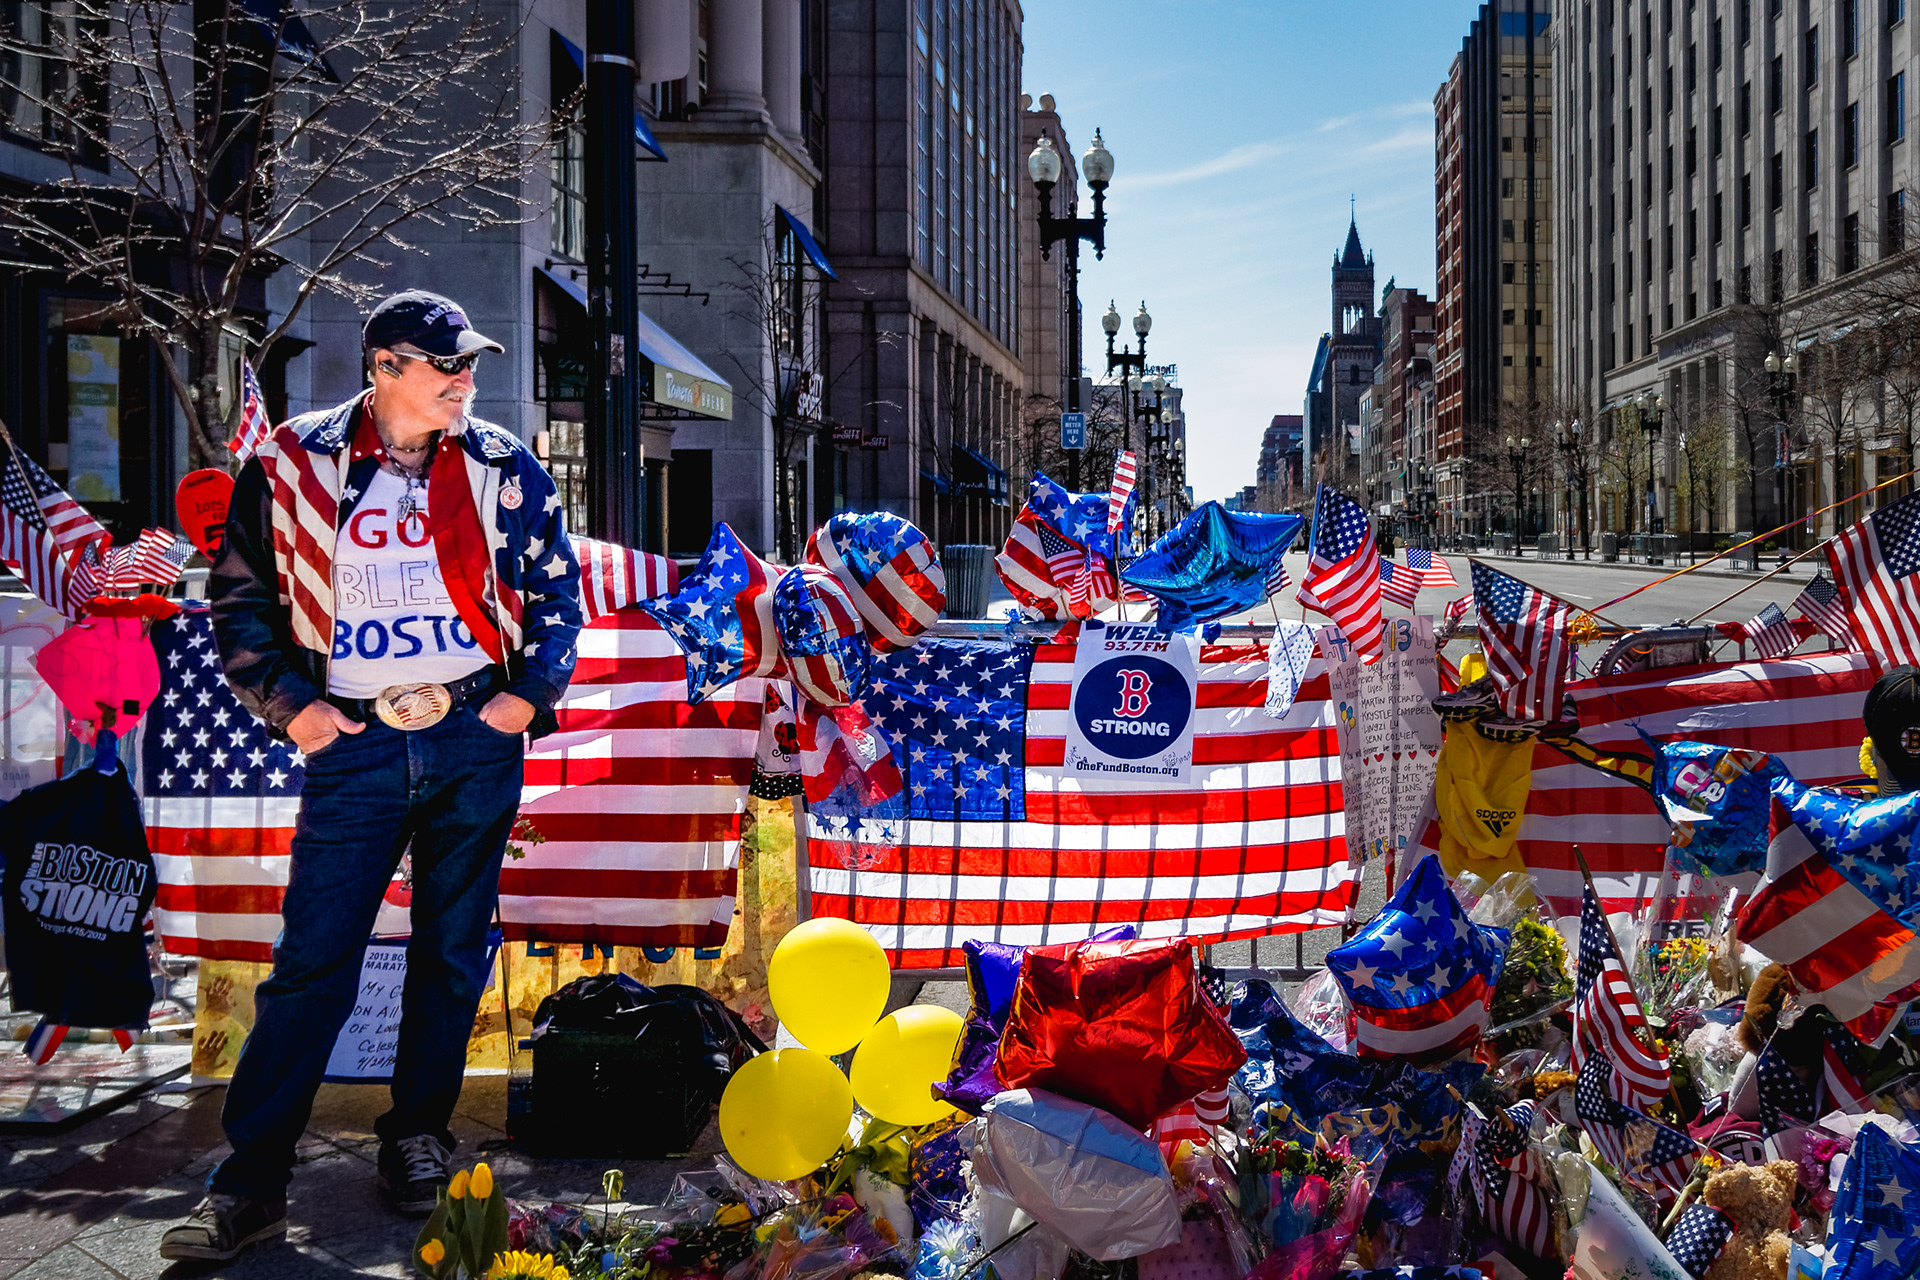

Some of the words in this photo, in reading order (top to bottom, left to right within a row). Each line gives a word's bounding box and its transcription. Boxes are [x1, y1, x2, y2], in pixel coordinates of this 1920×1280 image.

[809, 373, 824, 397] CITY
[797, 393, 822, 421] SPORTS
[350, 508, 432, 549] GO
[332, 615, 477, 659] BOSTO
[1387, 657, 1398, 670] for
[1401, 659, 1414, 667] our
[1113, 669, 1154, 719] B
[1090, 719, 1170, 737] STRONG
[1076, 761, 1179, 777] OneFundBoston.org
[1380, 765, 1387, 774] to
[1404, 763, 1411, 772] of
[1416, 763, 1428, 773] the
[1393, 812, 1407, 826] city
[1475, 808, 1516, 821] adidas
[31, 842, 45, 862] Are
[1370, 836, 1390, 859] ARE
[25, 862, 41, 878] We
[37, 843, 148, 897] BOSTON
[66, 923, 107, 942] 4/15/2013
[368, 952, 389, 962] 2013
[389, 985, 403, 999] C
[349, 1024, 371, 1034] OF
